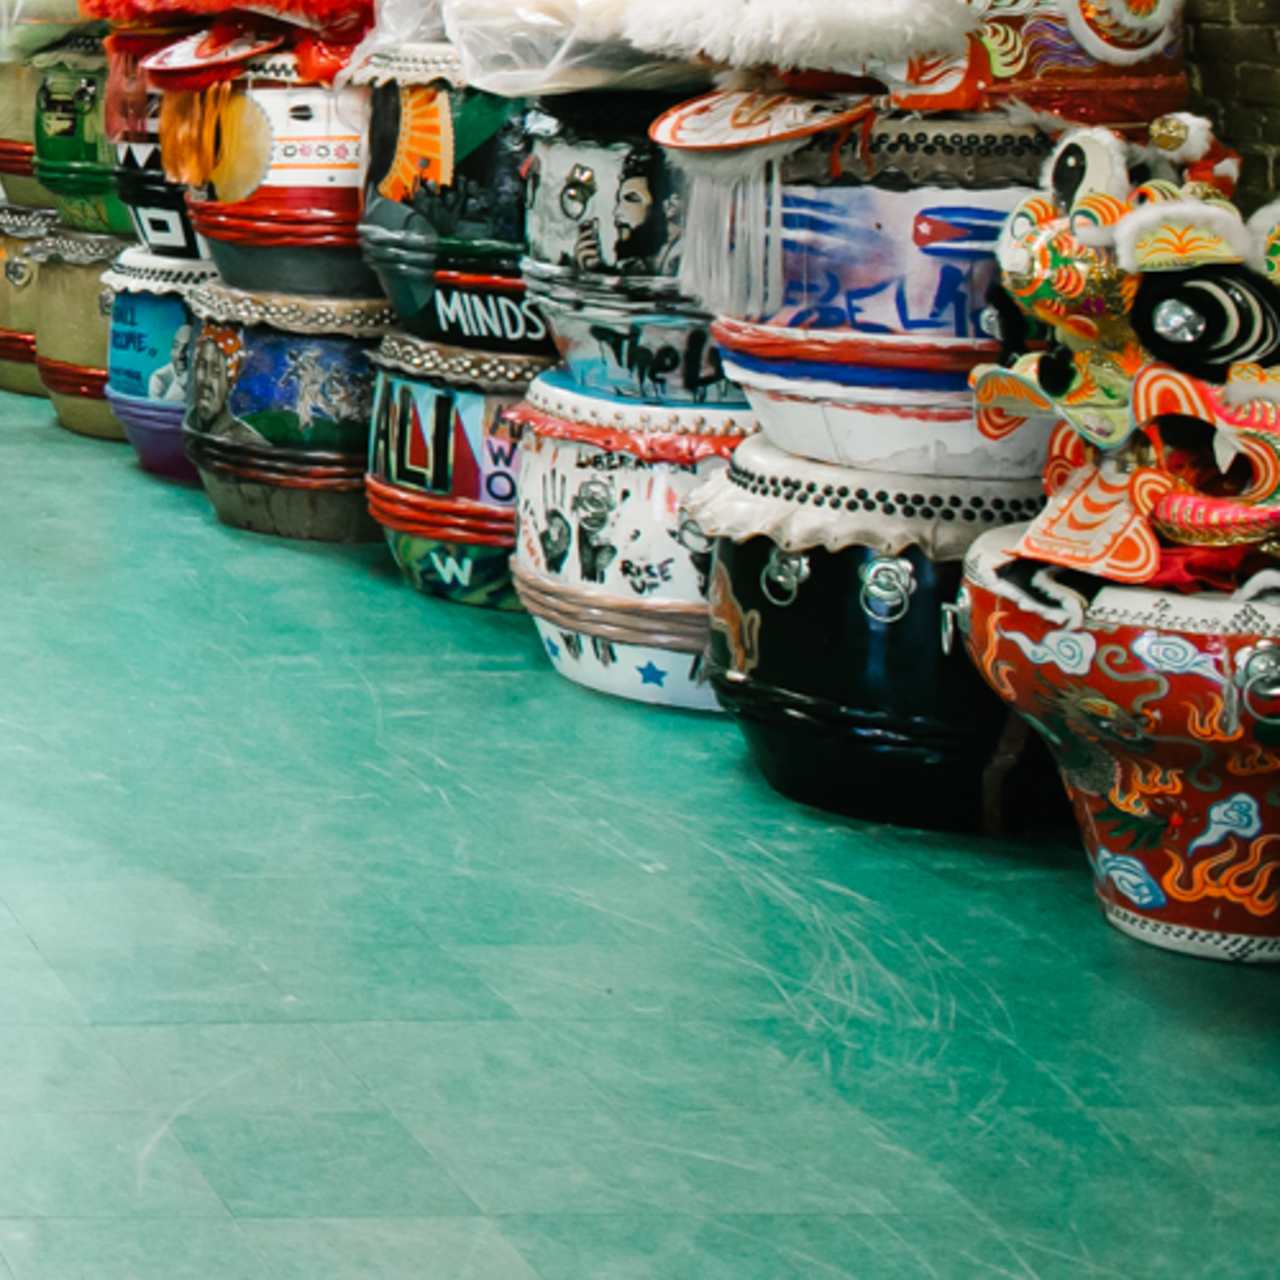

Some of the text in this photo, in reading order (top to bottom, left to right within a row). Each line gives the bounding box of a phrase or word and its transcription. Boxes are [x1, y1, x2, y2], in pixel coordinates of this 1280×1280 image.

[435, 289, 544, 341] MINDS
[590, 324, 680, 390] The
[373, 375, 454, 494] ALI
[620, 558, 674, 582] RISE
